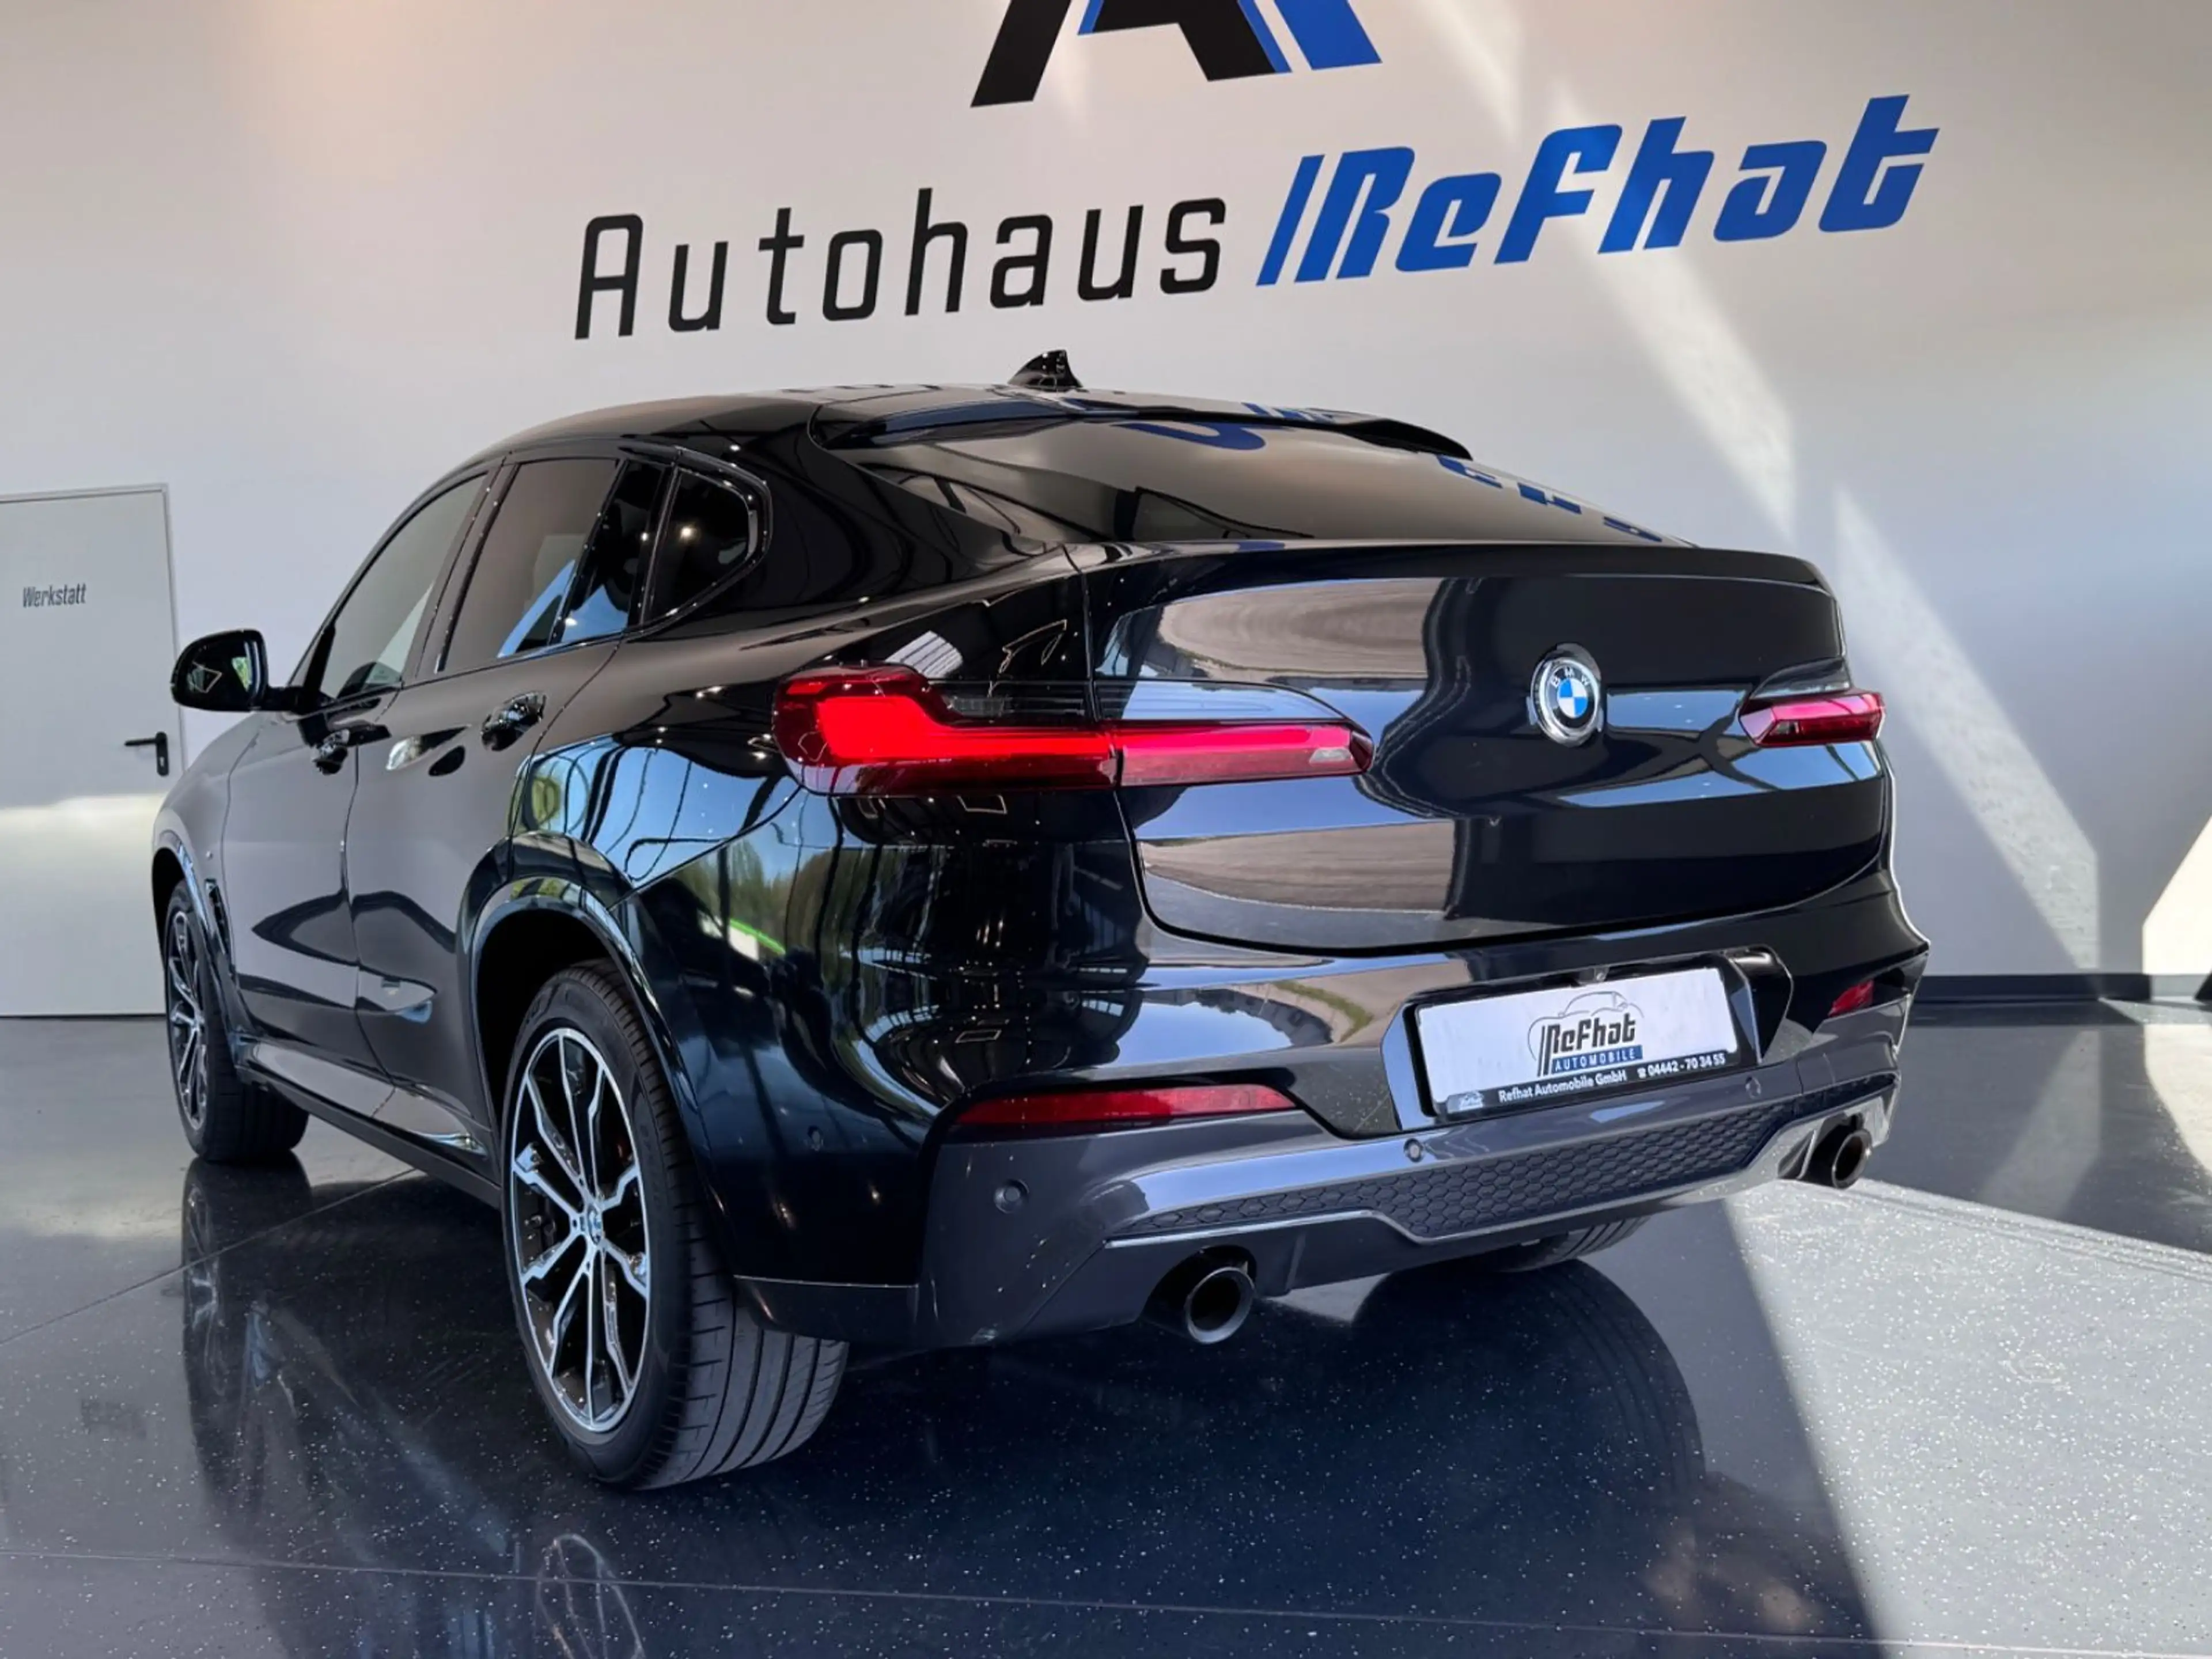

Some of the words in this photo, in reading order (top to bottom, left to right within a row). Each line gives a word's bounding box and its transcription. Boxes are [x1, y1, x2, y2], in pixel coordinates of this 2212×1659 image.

[576, 188, 1225, 339] Autohaus
[1257, 96, 1937, 285] Refhat
[22, 582, 86, 608] Werkstatt
[1550, 666, 1590, 687] BMW
[1536, 1013, 1636, 1077] Refhat
[1555, 1048, 1635, 1071] AUTOMOBILE
[1498, 1086, 1532, 1103] Refhat
[1534, 1075, 1594, 1096] Automobile
[1595, 1069, 1627, 1085] GmbH
